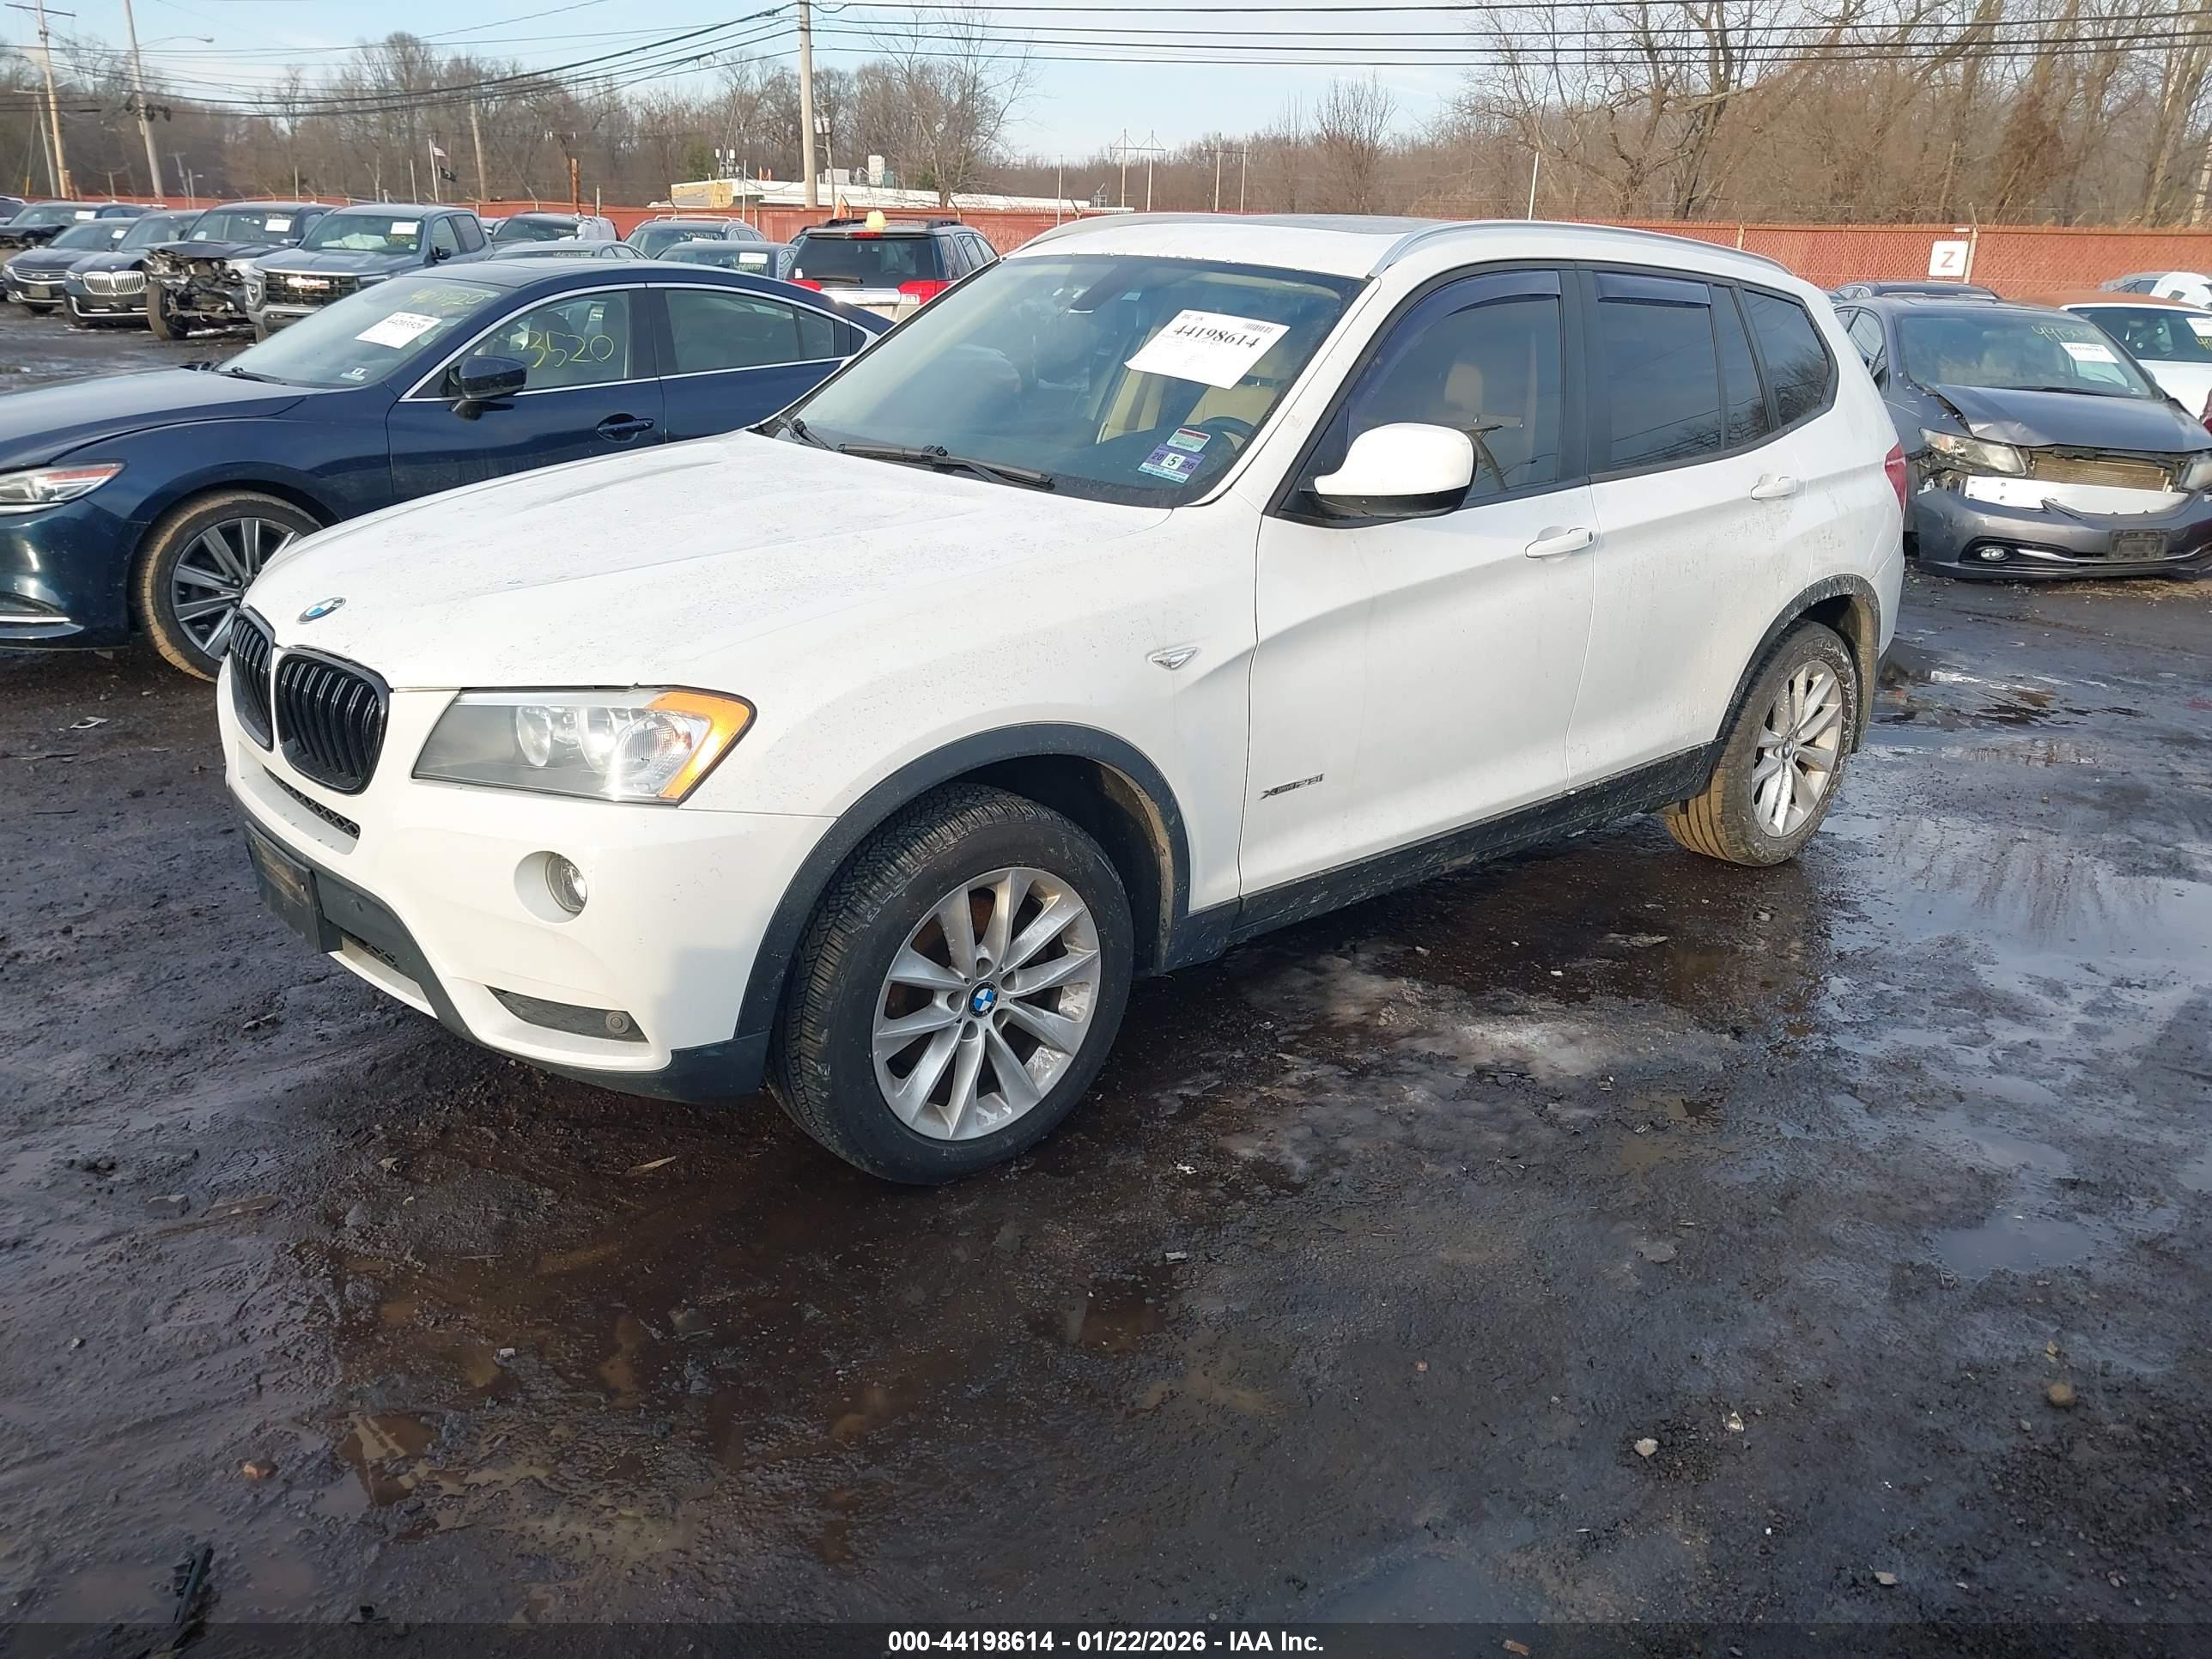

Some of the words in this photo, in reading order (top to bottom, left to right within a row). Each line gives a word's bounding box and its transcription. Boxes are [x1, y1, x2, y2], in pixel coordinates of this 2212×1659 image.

[1940, 251, 1956, 268] Z
[1173, 324, 1261, 349] 44198614
[528, 330, 614, 368] 3520
[1152, 453, 1165, 461] 20
[1167, 456, 1180, 467] 5
[1181, 461, 1196, 471] 26
